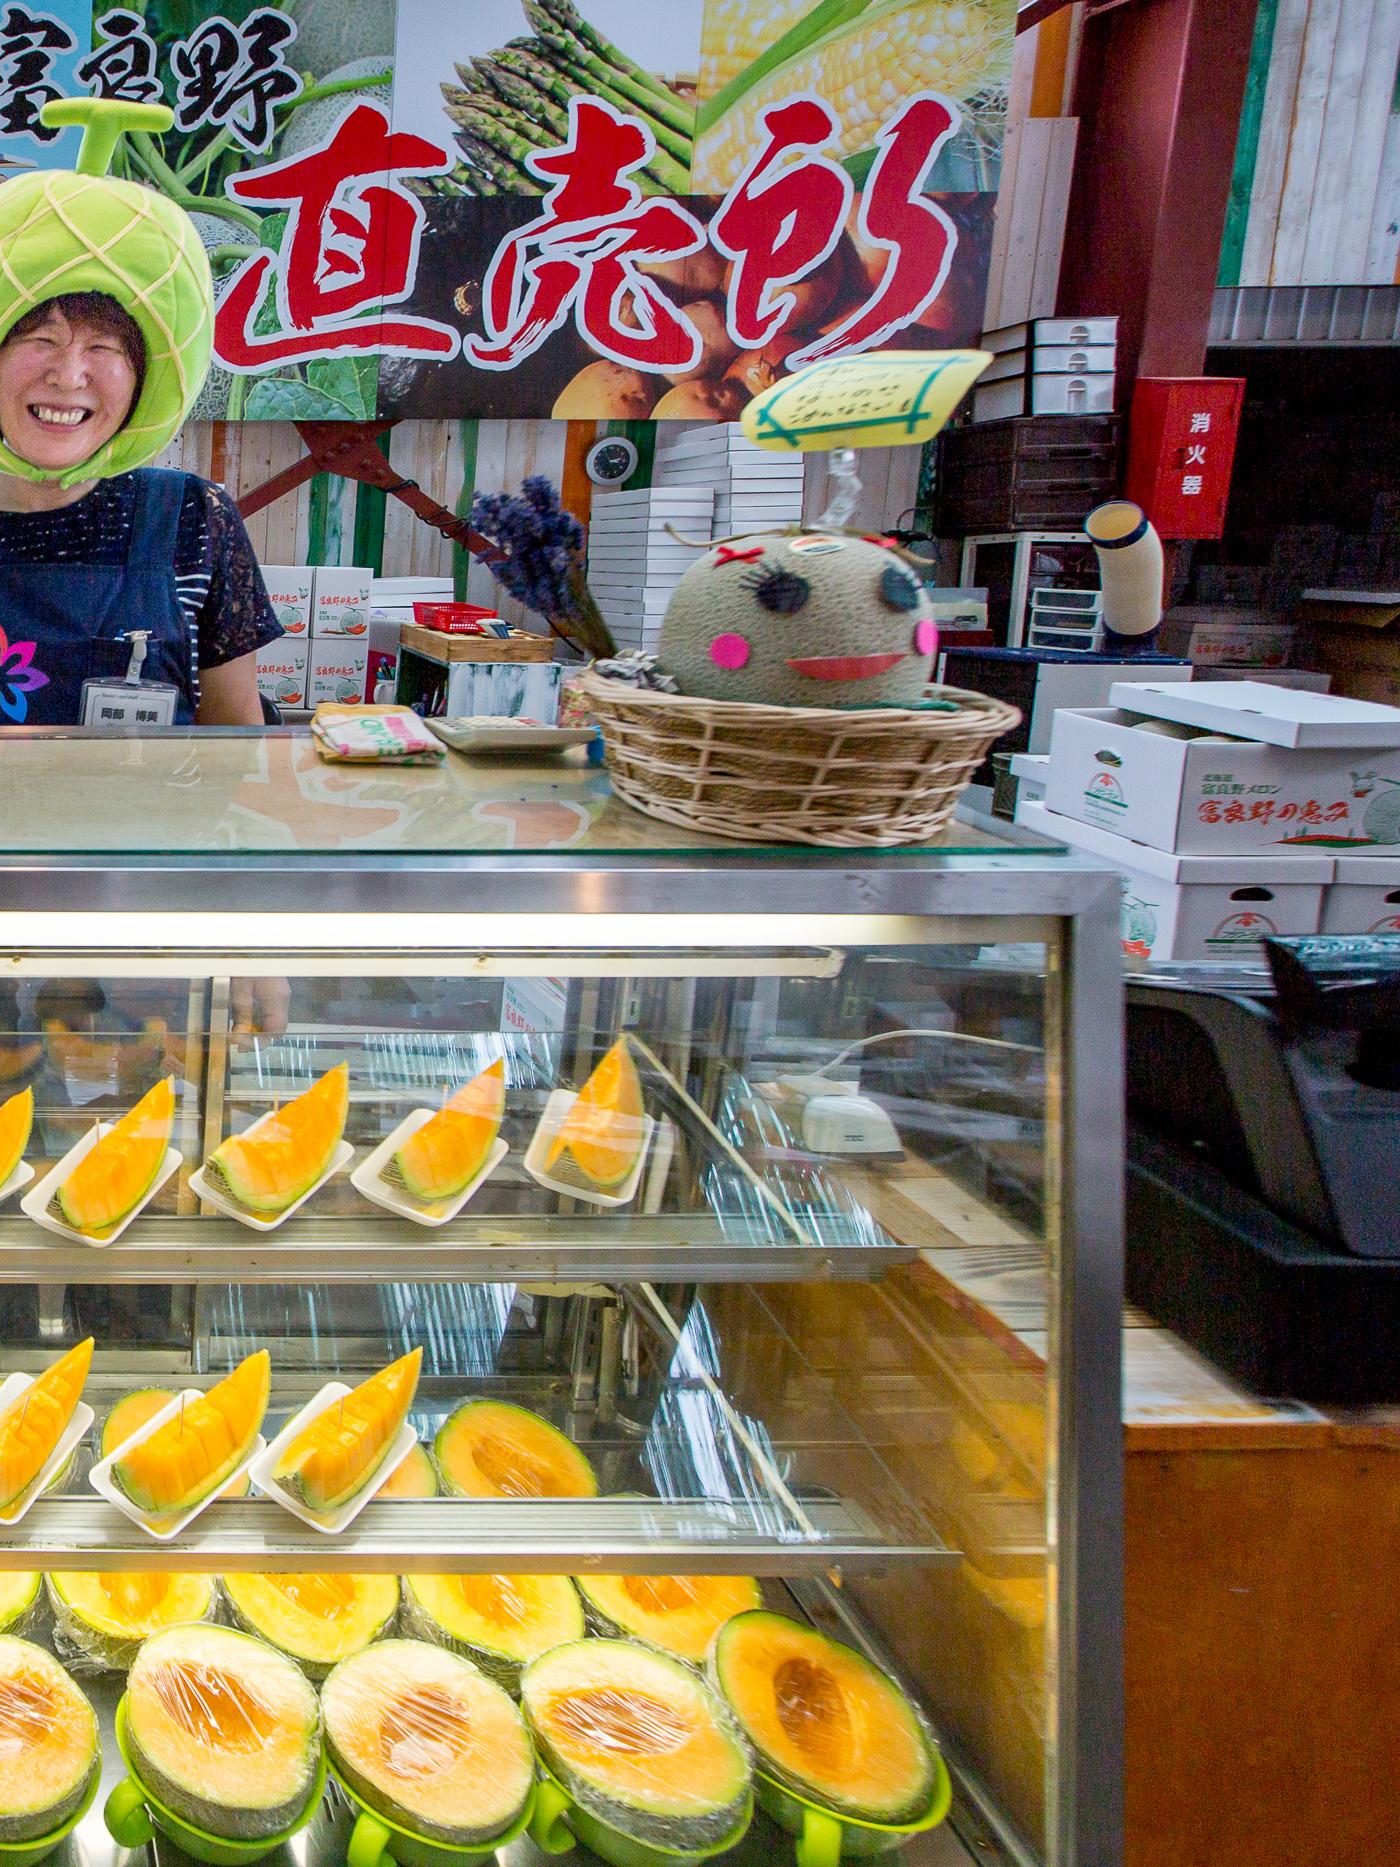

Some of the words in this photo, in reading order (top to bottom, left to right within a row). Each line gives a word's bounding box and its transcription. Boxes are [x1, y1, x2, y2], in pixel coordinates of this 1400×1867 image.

[213, 96, 959, 370] 直売所
[1181, 412, 1212, 495] 消火器
[1197, 798, 1350, 827] 富良野の恵み
